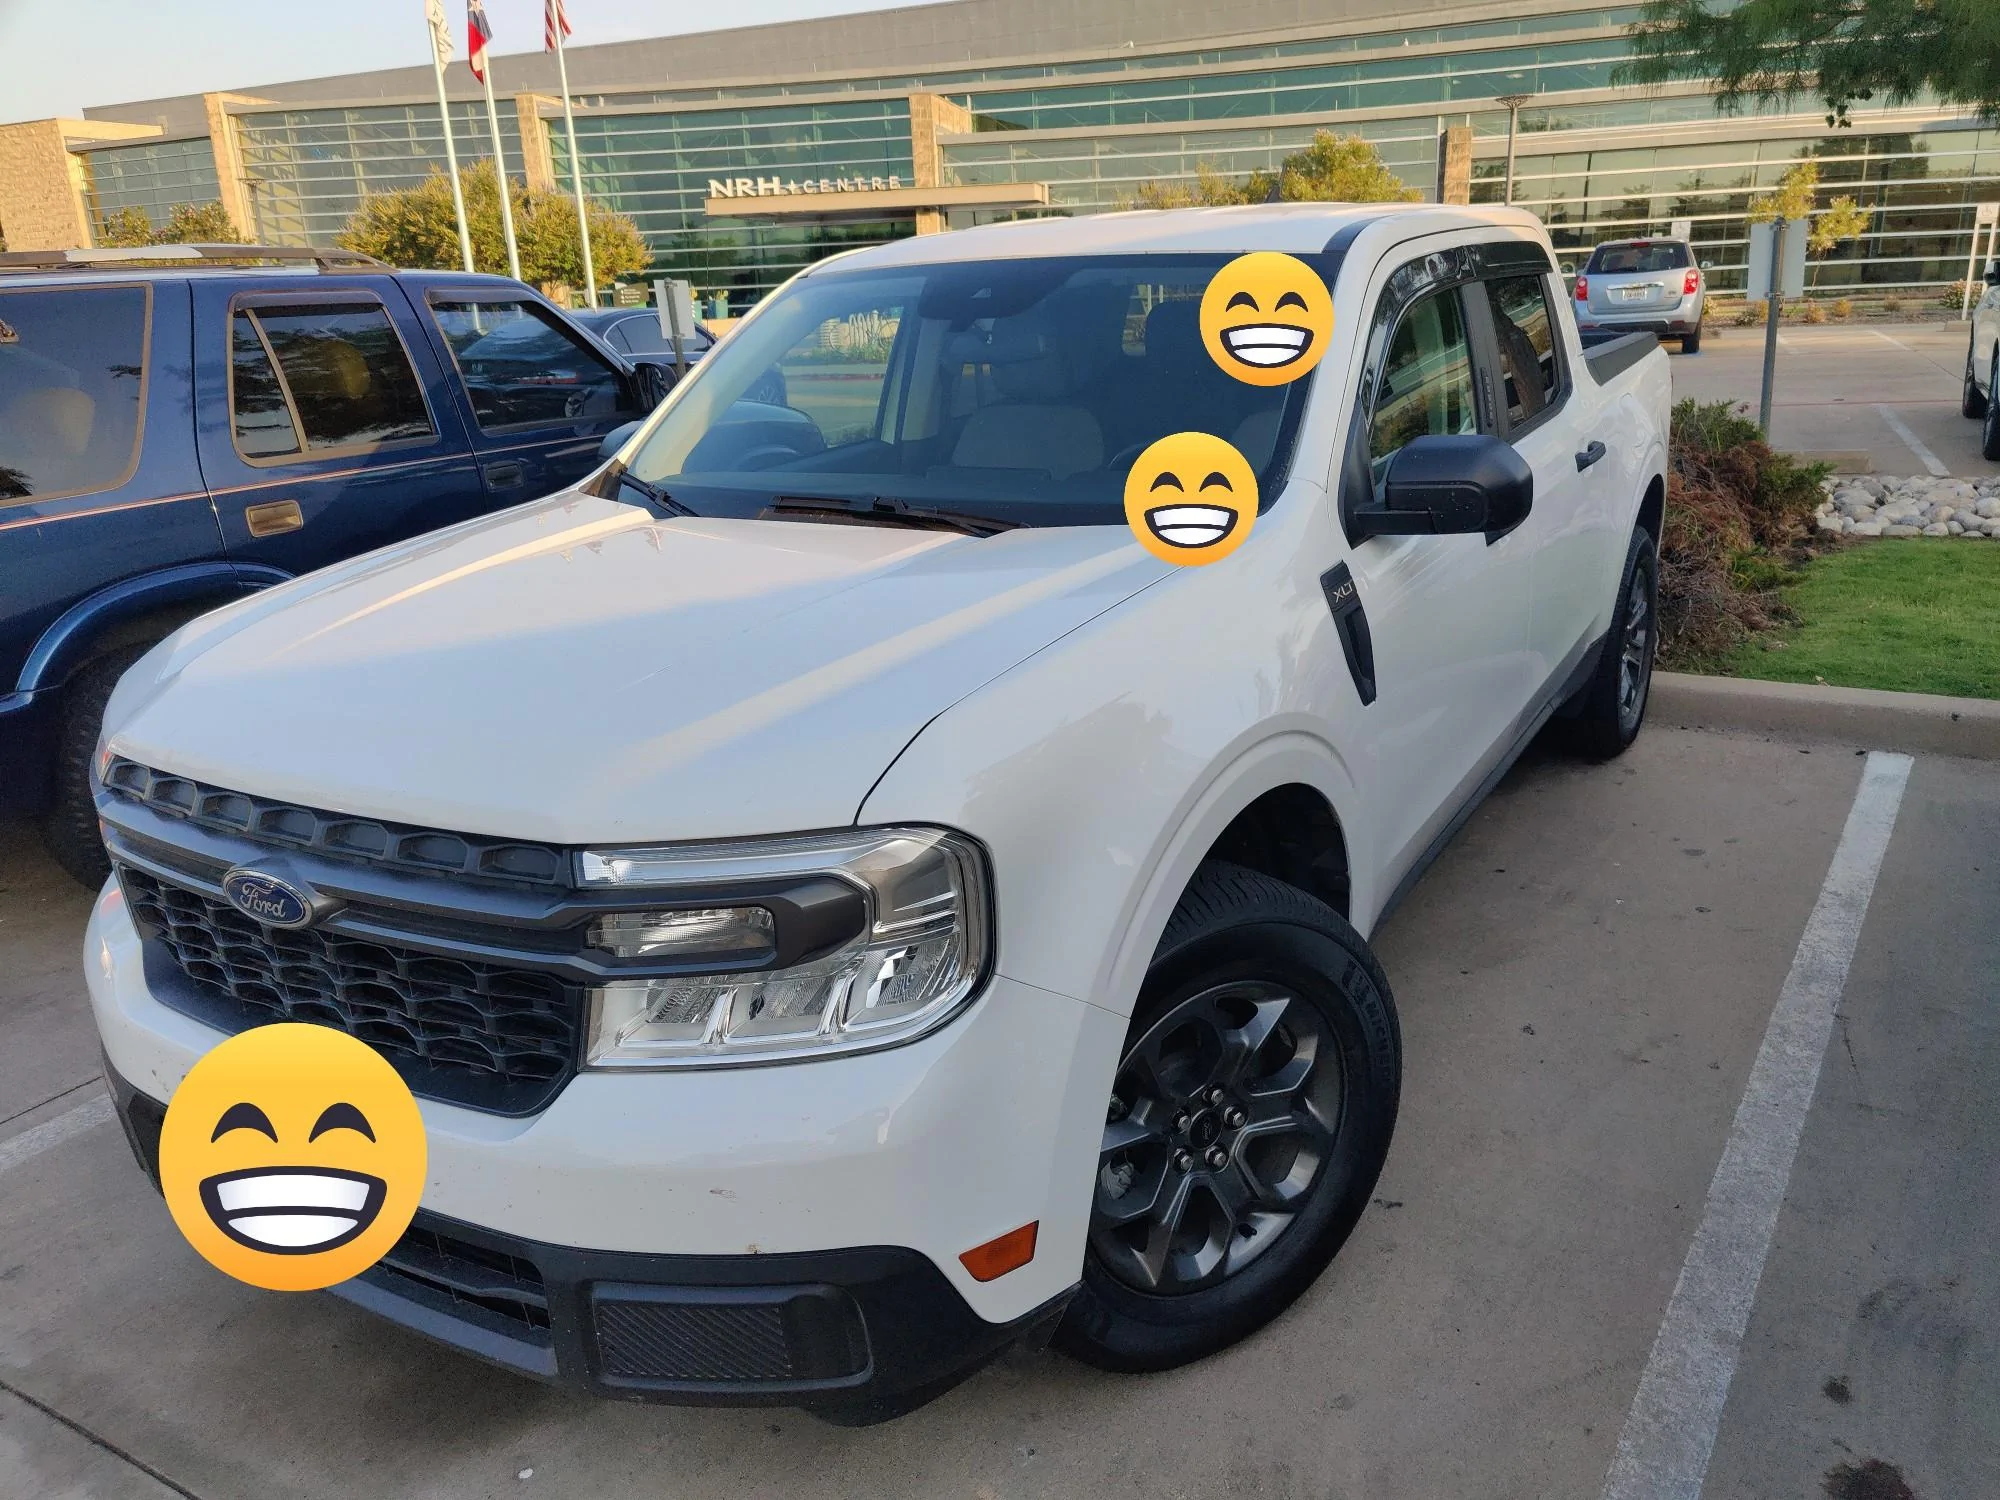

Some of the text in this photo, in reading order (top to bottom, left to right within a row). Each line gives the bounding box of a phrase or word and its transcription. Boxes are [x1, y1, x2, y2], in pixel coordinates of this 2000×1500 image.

[708, 176, 901, 199] NRH CENTRE
[1332, 579, 1353, 603] XLT
[240, 882, 286, 917] Ford
